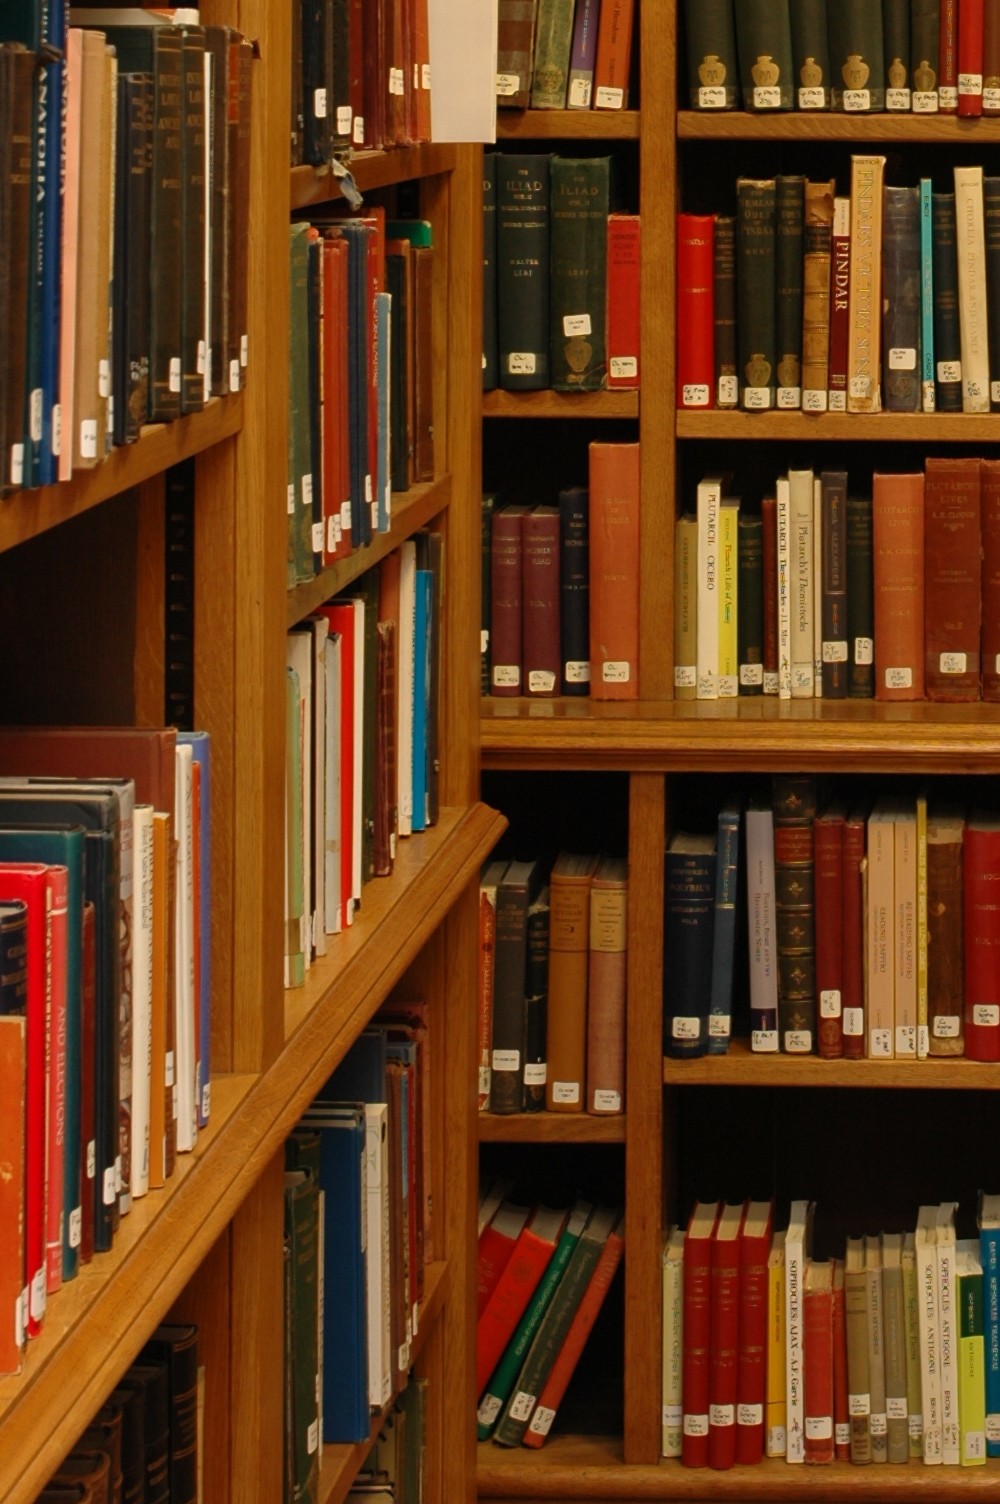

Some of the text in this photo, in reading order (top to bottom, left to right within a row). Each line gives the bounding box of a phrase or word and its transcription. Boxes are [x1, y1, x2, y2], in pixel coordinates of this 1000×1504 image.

[36, 65, 48, 203] ANATOLIA
[506, 181, 543, 192] ILIAD
[560, 184, 599, 196] ILIAD
[834, 241, 848, 312] PINDAR
[857, 170, 874, 331] PINDAR'S VICTORY
[966, 251, 977, 296] PINDAR
[968, 298, 978, 319] AND
[968, 321, 979, 358] DANCE
[705, 554, 716, 591] CICERO
[724, 577, 733, 592] Life
[797, 526, 809, 633] Plutarch's Themistocles
[831, 530, 840, 587] ALEXANDER
[54, 1004, 66, 1147] AND ELECTIONS
[788, 1259, 799, 1322] SOPHOCLES:
[788, 1323, 799, 1349] AJAX
[925, 1263, 938, 1426] SOPHOCLES: ANTIGONE BROWN
[940, 1257, 953, 1419] SOPHOCLES: ANTIGONE BROWN
